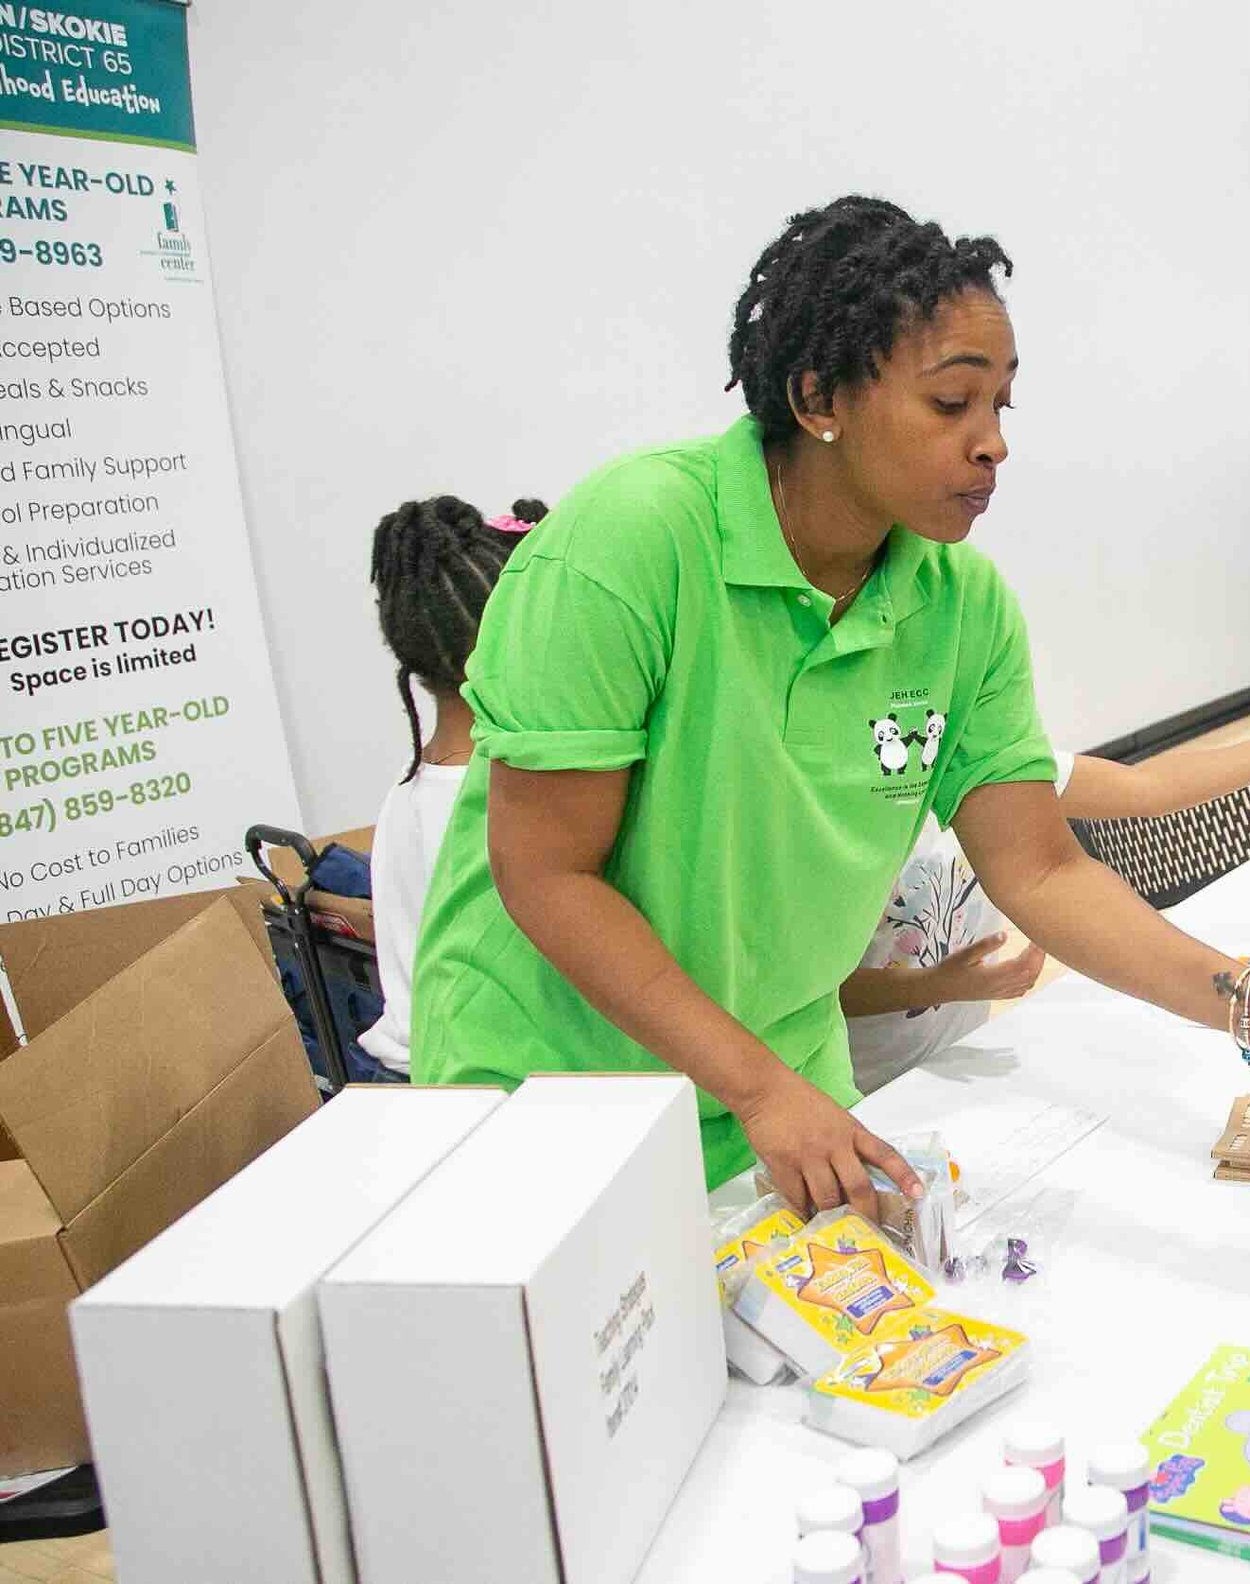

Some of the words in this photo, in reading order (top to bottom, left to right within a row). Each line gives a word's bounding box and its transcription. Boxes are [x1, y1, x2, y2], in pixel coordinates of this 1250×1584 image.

[0, 34, 95, 69] ISTRICT
[103, 50, 133, 75] 65
[61, 75, 161, 115] Education
[18, 162, 155, 196] YEAR-OLD
[0, 196, 69, 222] AMS
[160, 257, 194, 271] center
[9, 296, 82, 318] Based
[88, 298, 171, 324] Options
[0, 336, 100, 364] ccepted
[48, 377, 64, 398] &
[71, 376, 149, 398] Snacks
[0, 461, 16, 482] d
[22, 457, 97, 483] Family
[103, 453, 187, 480] Support
[2, 502, 22, 523] ol
[28, 495, 160, 524] Preparation
[3, 545, 20, 566] &
[26, 529, 176, 563] Individualized
[61, 559, 153, 584] Services
[114, 607, 215, 643] TODAY!
[10, 665, 88, 697] Space
[92, 658, 112, 678] is
[117, 643, 197, 674] limited
[0, 732, 36, 759] TO
[42, 720, 99, 751] FIVE
[103, 695, 230, 738] YEAR-OLD
[4, 740, 157, 792] PROGRAMS
[64, 771, 192, 822] 859-8320
[30, 853, 84, 882] Cost
[89, 849, 111, 868] to
[116, 824, 200, 861] Families
[58, 896, 75, 914] &
[81, 882, 116, 909] Full
[121, 872, 162, 898] Day
[167, 850, 244, 885] Options
